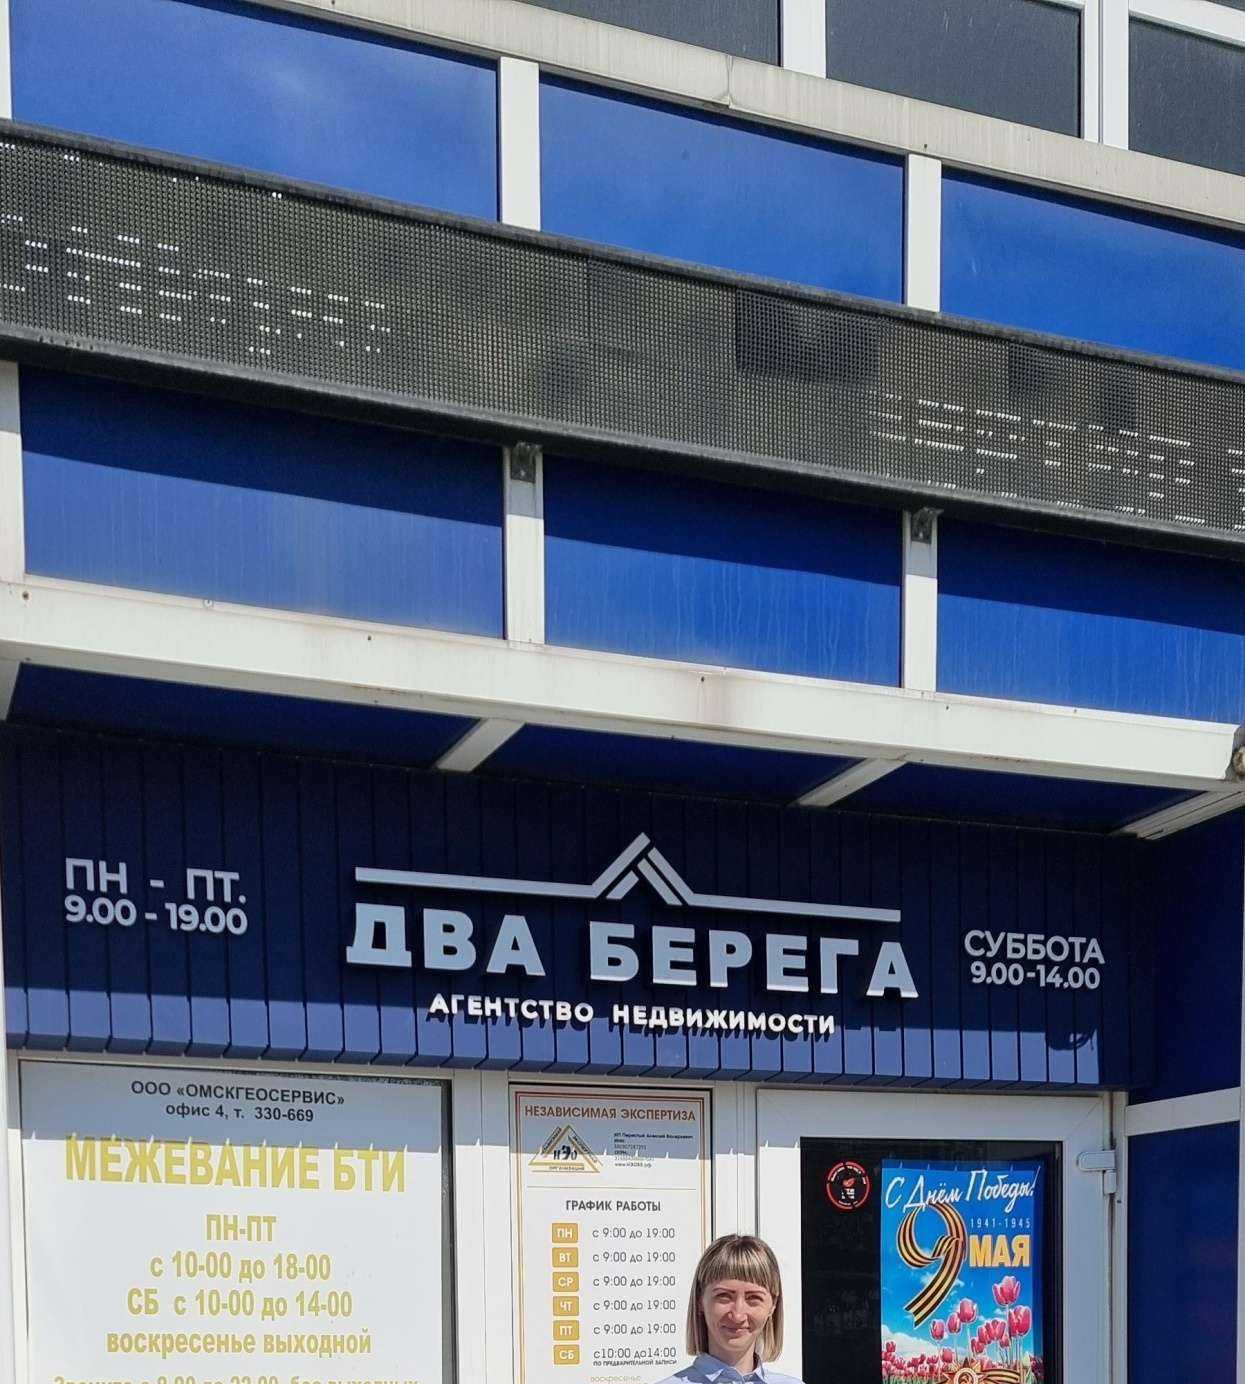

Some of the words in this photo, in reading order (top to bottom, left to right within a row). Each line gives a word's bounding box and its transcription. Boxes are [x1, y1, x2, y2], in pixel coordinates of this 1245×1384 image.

[65, 857, 128, 894] ПН
[186, 868, 247, 903] ПТ.
[64, 894, 136, 926] 9.00
[165, 902, 248, 935] 19.00
[346, 902, 546, 976] ДВА
[589, 920, 919, 998] БЕРЕГА
[964, 929, 1105, 965] СУББОТА
[970, 961, 1100, 990] 9.00-14.00
[429, 993, 594, 1022] АГЕНТСТВО
[612, 1004, 835, 1035] НЕДВИЖИМОСТИ
[131, 1080, 171, 1096] ООО
[176, 1083, 345, 1106] «ОМСКГЕОСЕРВИС»
[166, 1103, 210, 1120] офис
[215, 1105, 229, 1120] 4,
[233, 1107, 244, 1119] т.
[254, 1106, 314, 1122] 330-669
[525, 1106, 616, 1119] НЕЗАВИСИМАЯ
[621, 1109, 695, 1121] ЭКСПЕРТИЗА
[65, 1135, 320, 1190] МЕЖЕВАНИЕ
[334, 1148, 405, 1192] БТИ
[886, 1177, 905, 1208] С
[903, 1175, 963, 1212] Днём
[966, 1166, 1040, 1213] Победы!
[566, 1200, 612, 1211] ГРАФИК
[617, 1201, 661, 1212] РАБОТЫ
[206, 1214, 276, 1242] ПН-ПТ
[557, 1228, 572, 1238] ПН
[592, 1230, 599, 1238] с
[603, 1228, 626, 1238] 9:00
[629, 1230, 642, 1239] до
[646, 1228, 675, 1238] 19:00
[970, 1218, 1031, 1228] 1941-1945
[150, 1256, 163, 1278] с
[172, 1251, 231, 1279] 10-00
[239, 1257, 265, 1282] до
[274, 1253, 331, 1280] 18-00
[559, 1253, 571, 1262] ВТ
[593, 1254, 599, 1262] с
[603, 1252, 627, 1262] 9:00
[630, 1254, 642, 1263] до
[647, 1252, 675, 1262] 19:00
[896, 1201, 968, 1329] 9
[969, 1234, 1030, 1267] МАЯ
[558, 1277, 574, 1287] СР
[593, 1278, 599, 1286] с
[603, 1276, 627, 1287] 9:00
[630, 1279, 643, 1287] до
[647, 1276, 676, 1286] 19:00
[127, 1288, 159, 1315] СБ
[174, 1295, 186, 1315] с
[195, 1289, 254, 1316] 10-00
[261, 1296, 287, 1321] до
[296, 1291, 353, 1317] 14-00
[560, 1301, 572, 1311] ЧТ
[604, 1300, 627, 1311] 9:00
[631, 1303, 643, 1311] до
[647, 1300, 676, 1310] 19:00
[107, 1330, 256, 1359] воскресенье
[264, 1328, 372, 1358] выходной
[559, 1325, 572, 1335] ПТ
[593, 1327, 600, 1335] с
[604, 1324, 627, 1335] 9:00
[631, 1327, 643, 1335] до
[647, 1324, 676, 1334] 19:00
[560, 1350, 574, 1360] СБ
